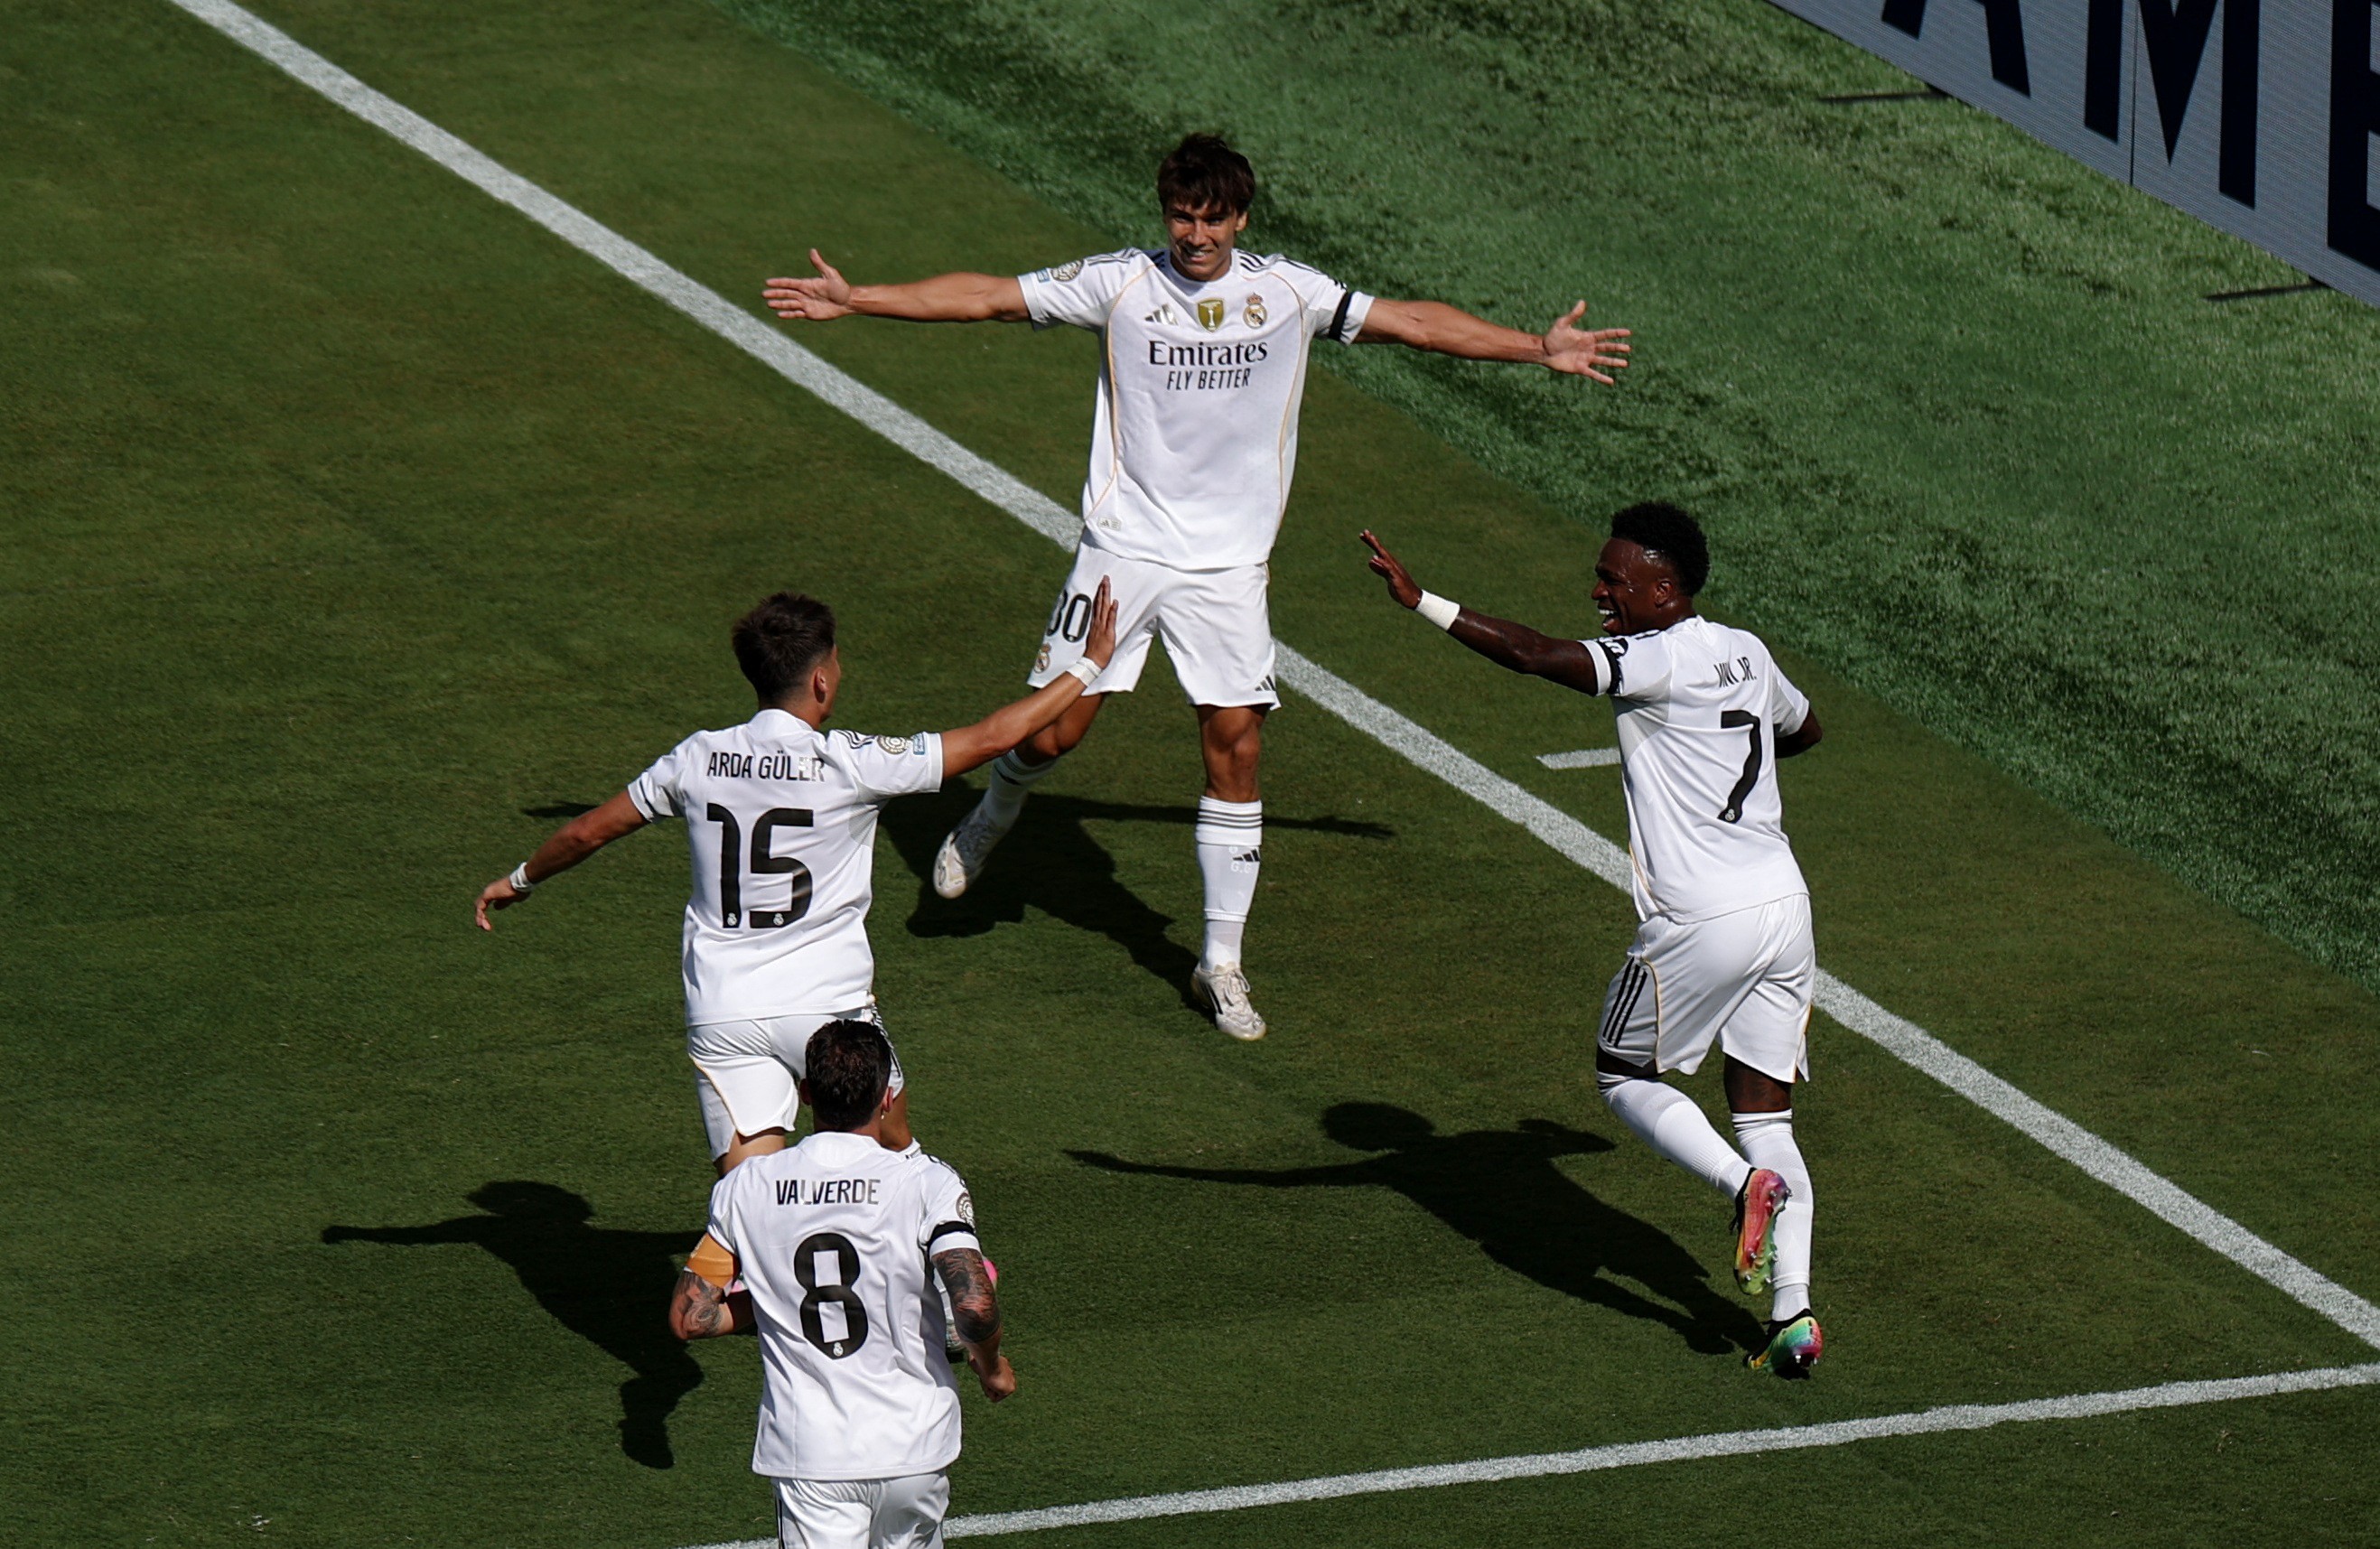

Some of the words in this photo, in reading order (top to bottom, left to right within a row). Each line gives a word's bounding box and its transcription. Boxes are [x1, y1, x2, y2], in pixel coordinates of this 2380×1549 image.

[1148, 340, 1268, 367] Emirates
[1166, 370, 1192, 391] FLY
[1197, 368, 1251, 390] BETTER
[706, 751, 752, 779] ARDA
[758, 750, 826, 783] GÜLER
[1717, 709, 1763, 825] 7
[706, 802, 814, 929] 15
[775, 1179, 881, 1206] VALVERDE
[793, 1232, 869, 1360] 8
